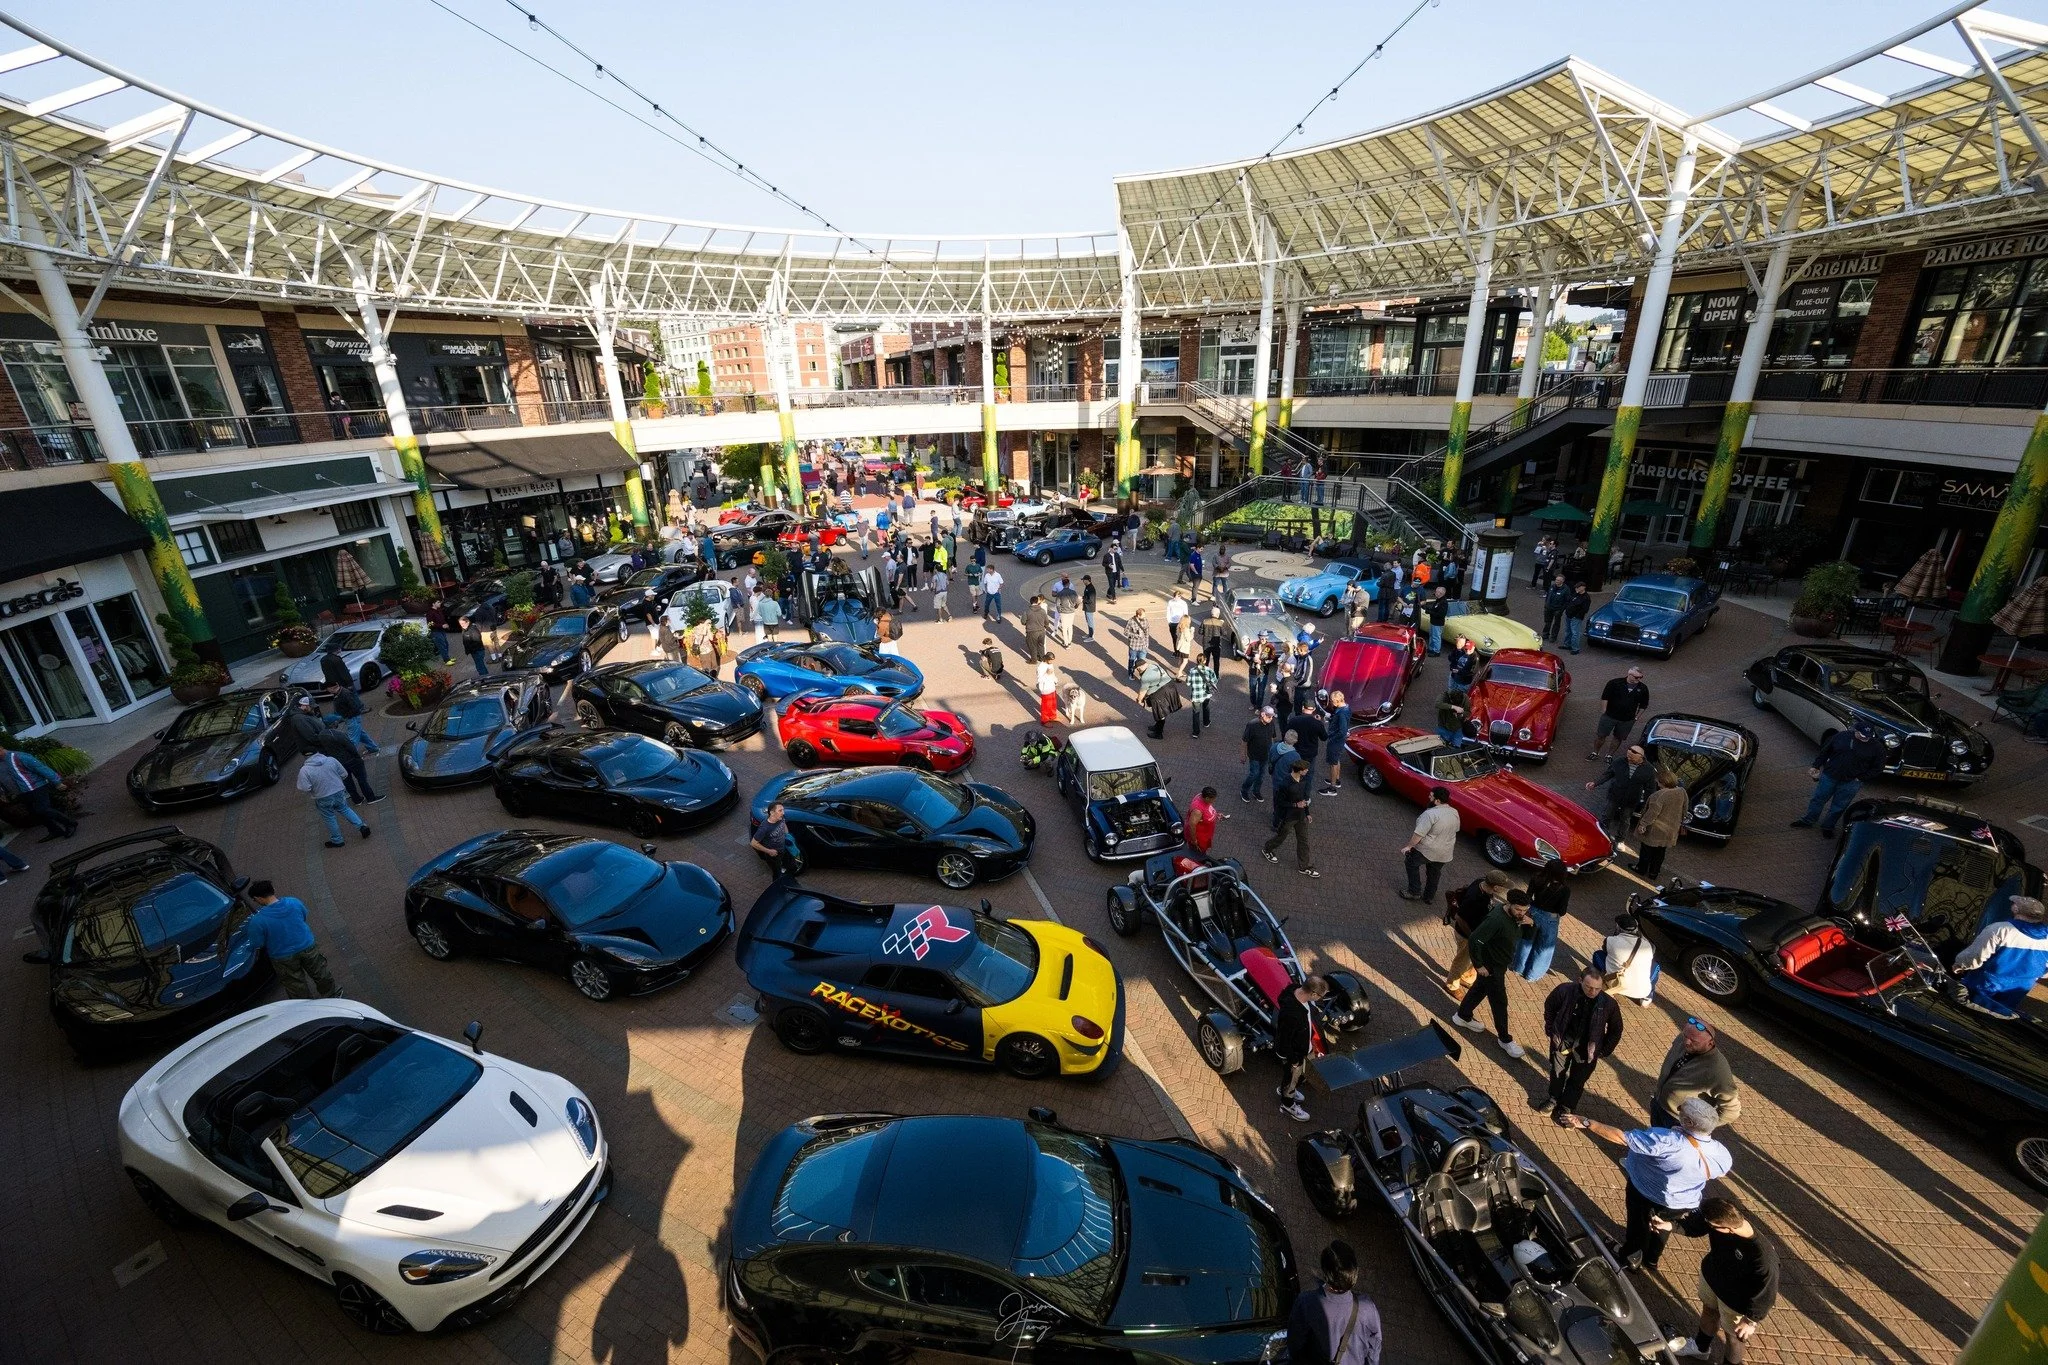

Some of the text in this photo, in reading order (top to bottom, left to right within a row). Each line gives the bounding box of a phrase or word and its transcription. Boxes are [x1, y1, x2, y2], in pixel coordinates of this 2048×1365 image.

[1924, 239, 2015, 266] PANCAKE
[1801, 255, 1880, 279] ORIGINAL
[1801, 286, 1830, 296] DINE-IN
[1707, 295, 1741, 309] NOW
[1795, 297, 1831, 307] TAKE-OUT
[1703, 309, 1738, 322] OPEN
[1791, 308, 1827, 318] DELIVERY
[86, 321, 159, 342] inluxe
[346, 348, 372, 356] RACIN
[1630, 462, 1790, 491] TARBUCKS OFFEE
[1938, 493, 2002, 509] CELLAR
[810, 981, 969, 1051] RACEXOTICS
